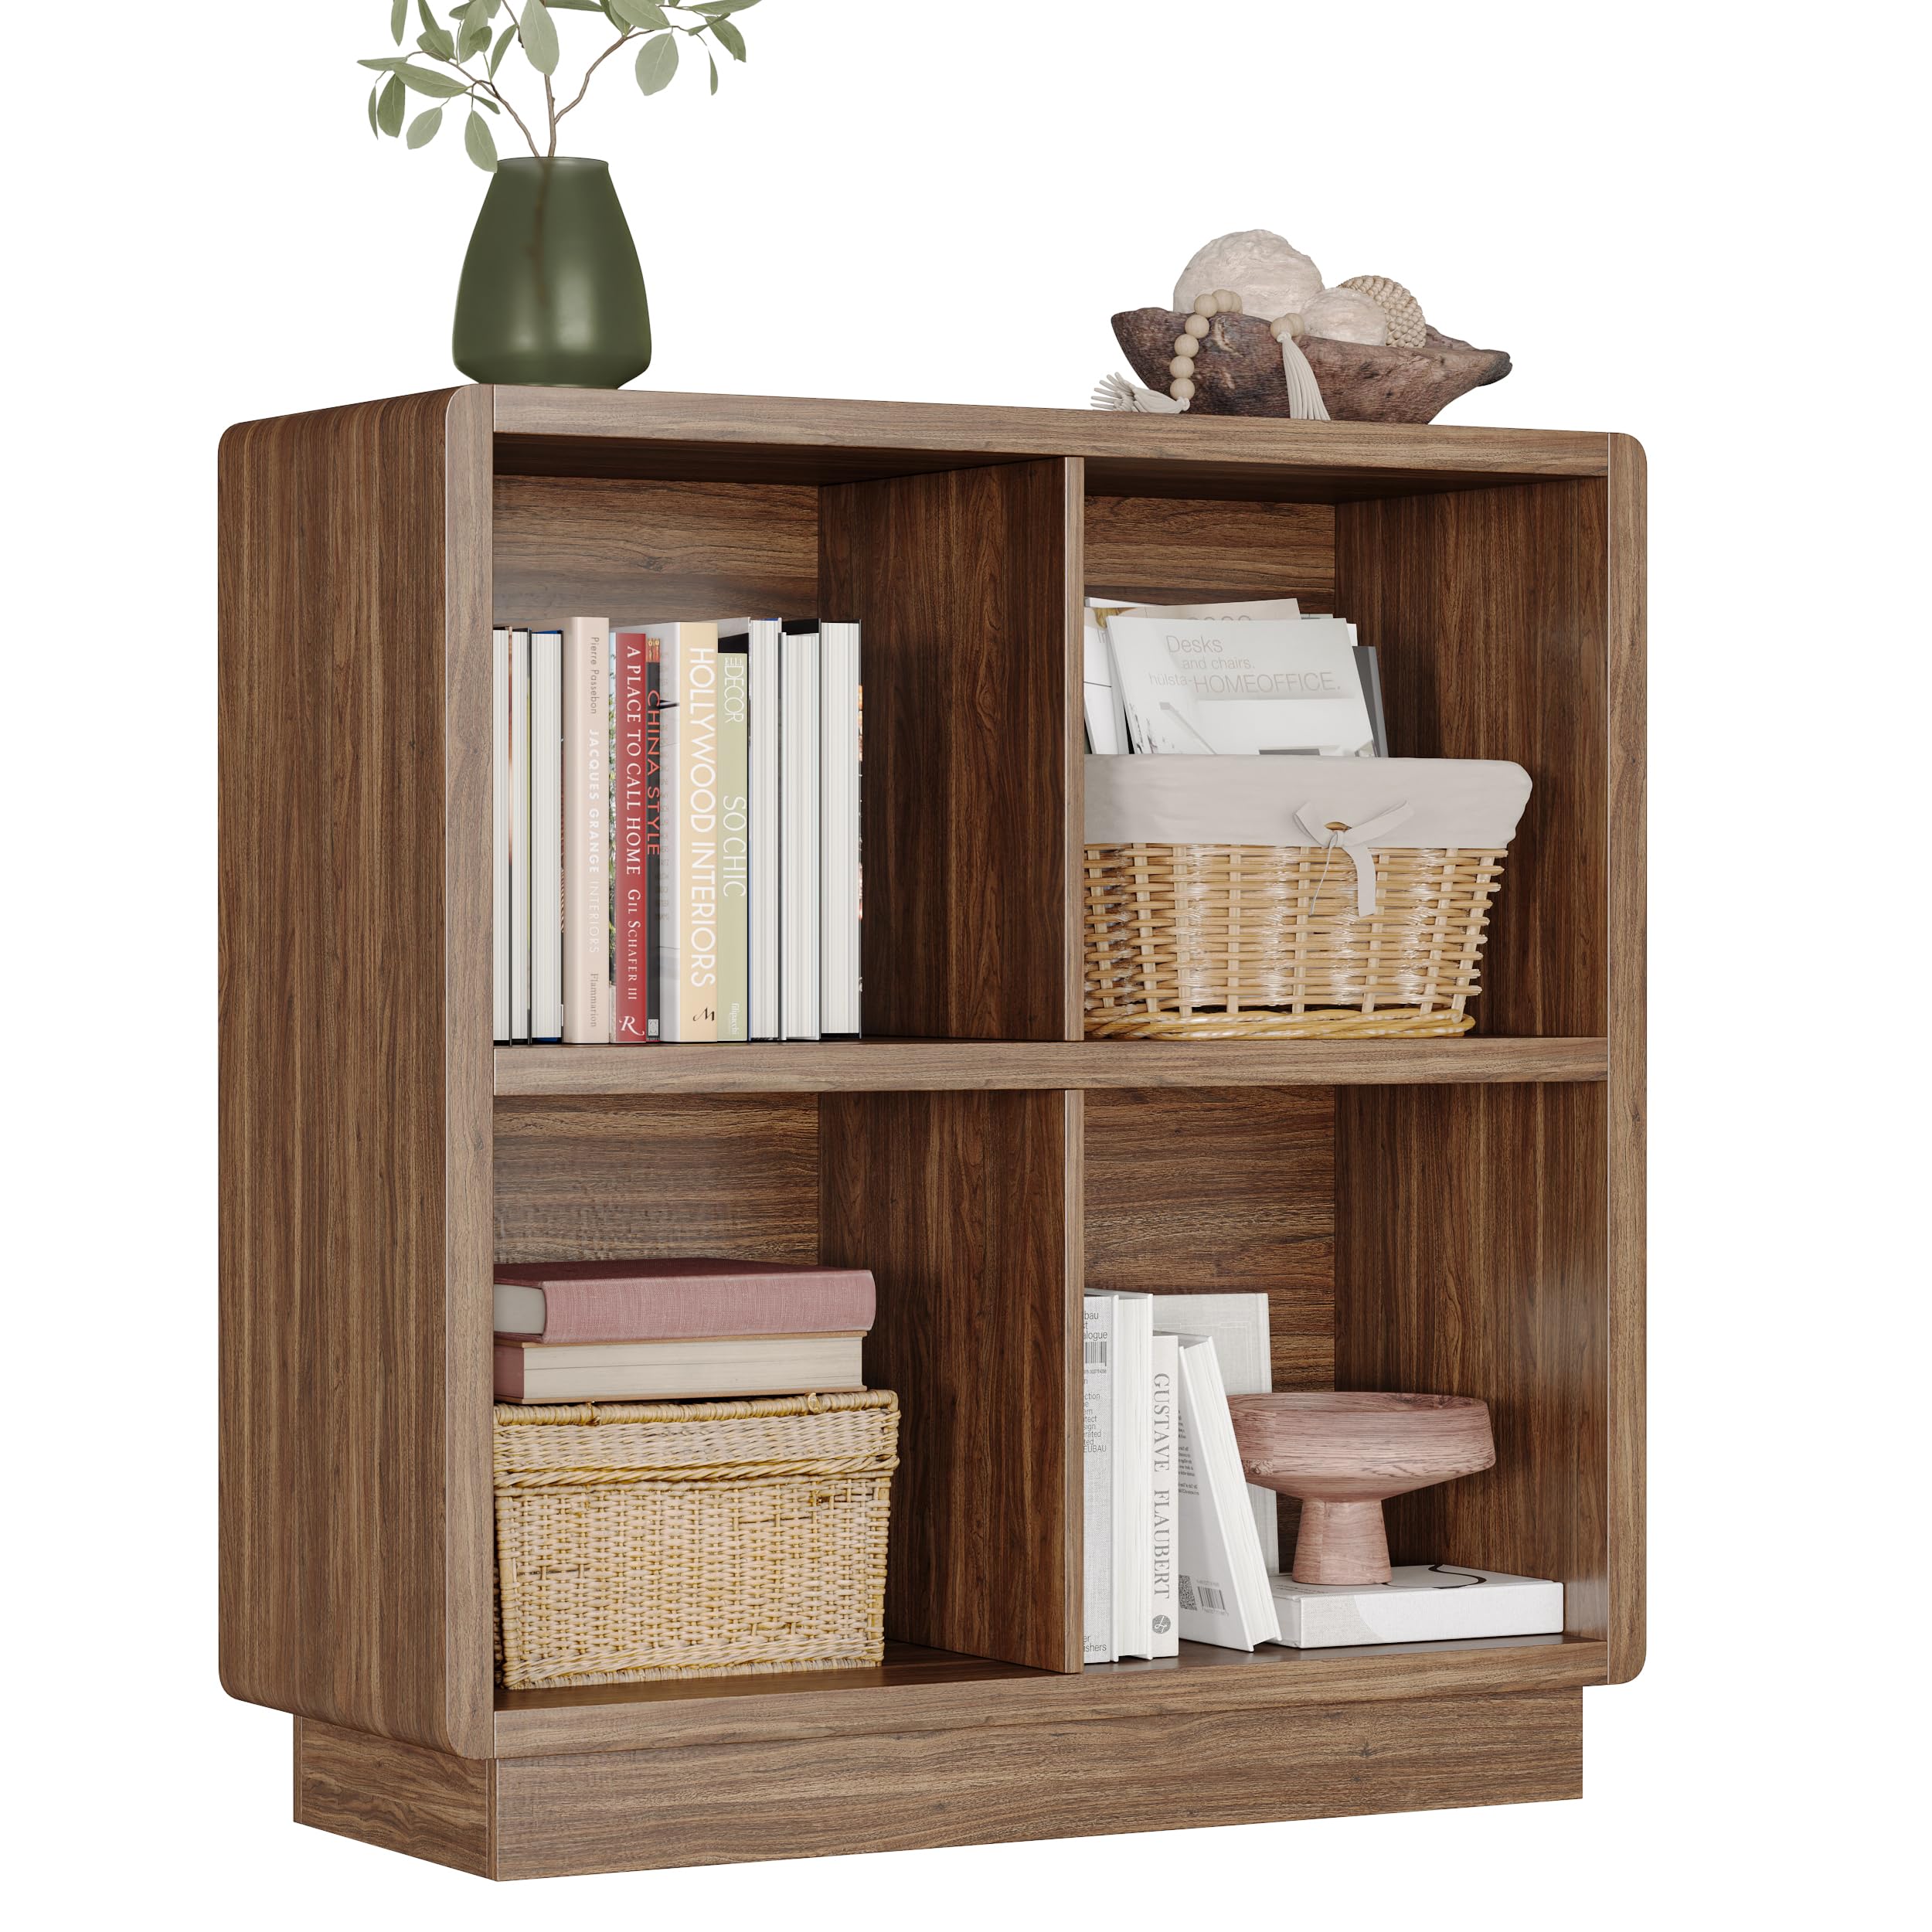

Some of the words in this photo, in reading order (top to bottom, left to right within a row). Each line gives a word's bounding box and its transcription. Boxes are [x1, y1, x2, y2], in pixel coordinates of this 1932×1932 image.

[590, 637, 600, 665] Pierre
[627, 646, 641, 658] A
[1165, 635, 1223, 653] Desks
[1182, 657, 1206, 669] and
[1211, 657, 1255, 669] chairs.
[590, 669, 600, 714] Passebon
[627, 665, 641, 723] PLACE
[627, 730, 641, 757] TO
[648, 690, 660, 775] CHINA
[689, 648, 716, 833] HOLLYWOOD
[589, 729, 600, 800] JACQUES
[627, 763, 641, 811] CALL
[589, 808, 600, 872] GRANGE
[648, 786, 660, 855] STYLE
[723, 795, 747, 832] SO
[626, 817, 641, 875] HOME
[723, 837, 747, 897] CHIC
[589, 881, 600, 953] INTERIORS
[691, 842, 716, 987] INTERIORS
[590, 973, 599, 1027] Flammarion
[628, 988, 638, 1000] III
[1154, 1373, 1170, 1472] GUSTAVE
[1154, 1490, 1170, 1599] FLAUBERT
